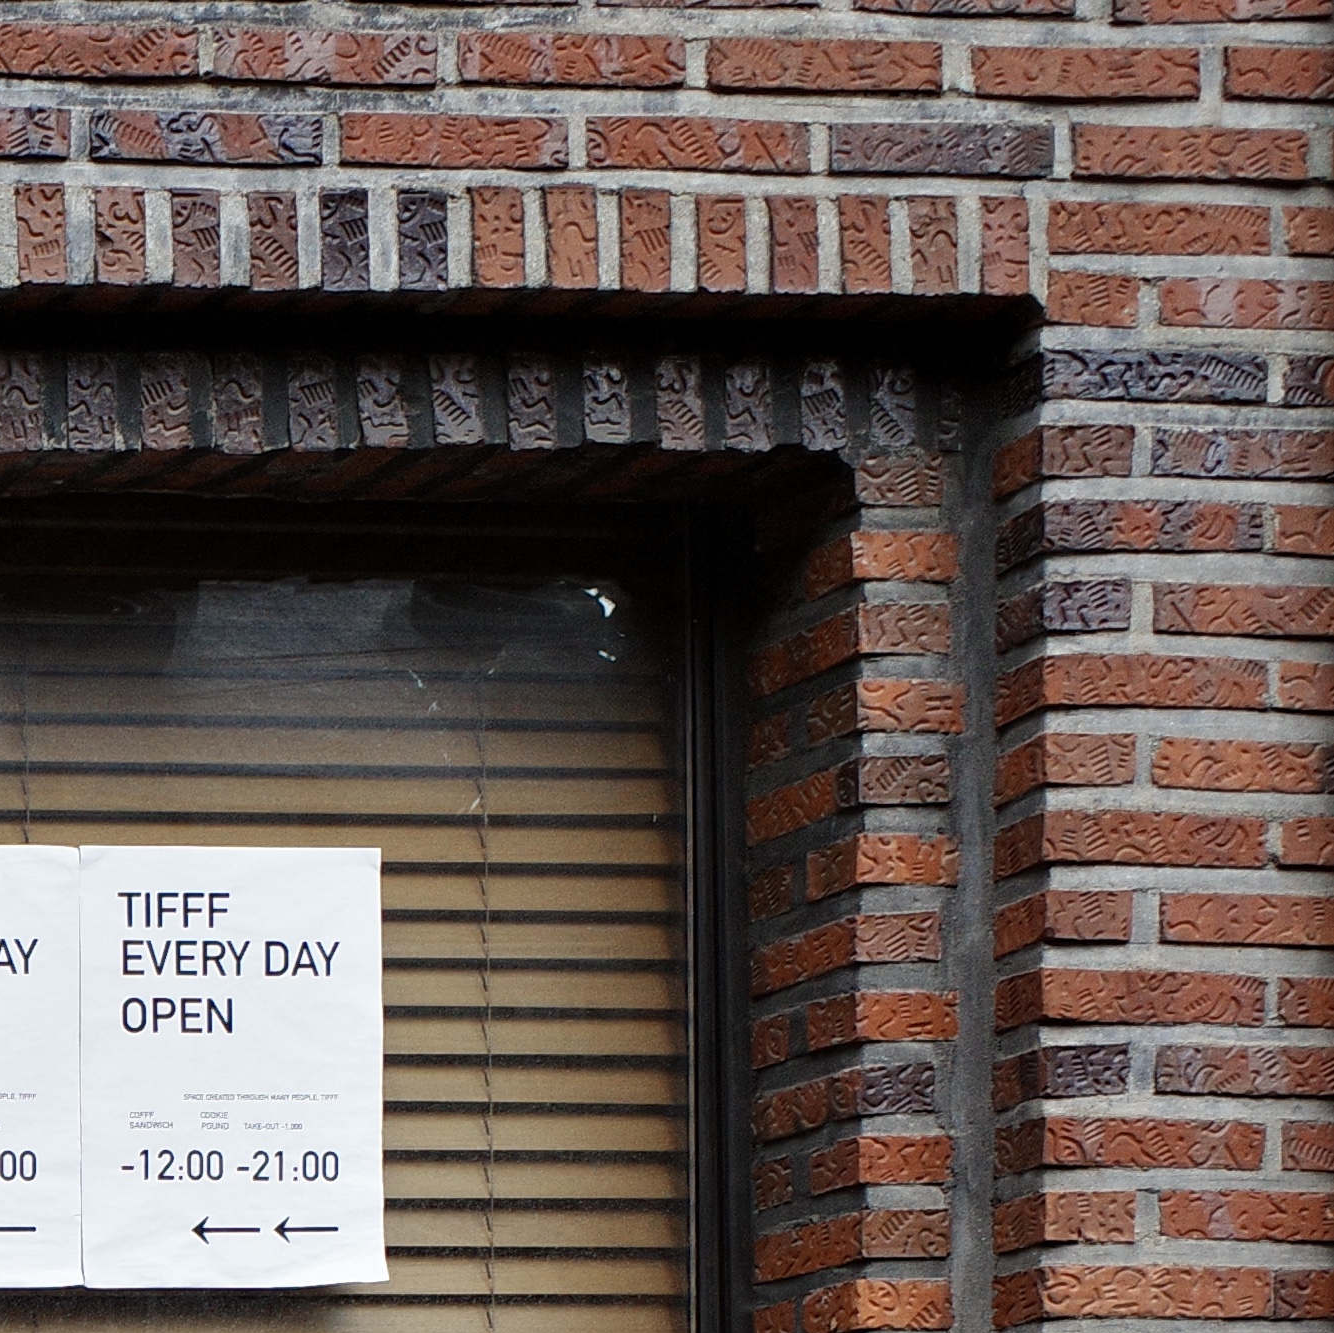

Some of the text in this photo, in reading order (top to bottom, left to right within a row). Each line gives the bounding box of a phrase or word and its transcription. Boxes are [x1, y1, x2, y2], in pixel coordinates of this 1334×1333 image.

[123, 940, 340, 976] EVERY DAY
[122, 998, 232, 1033] OPEN
[129, 1120, 174, 1130] SANDWICH
[121, 1150, 338, 1181] -12:00 -21:00
